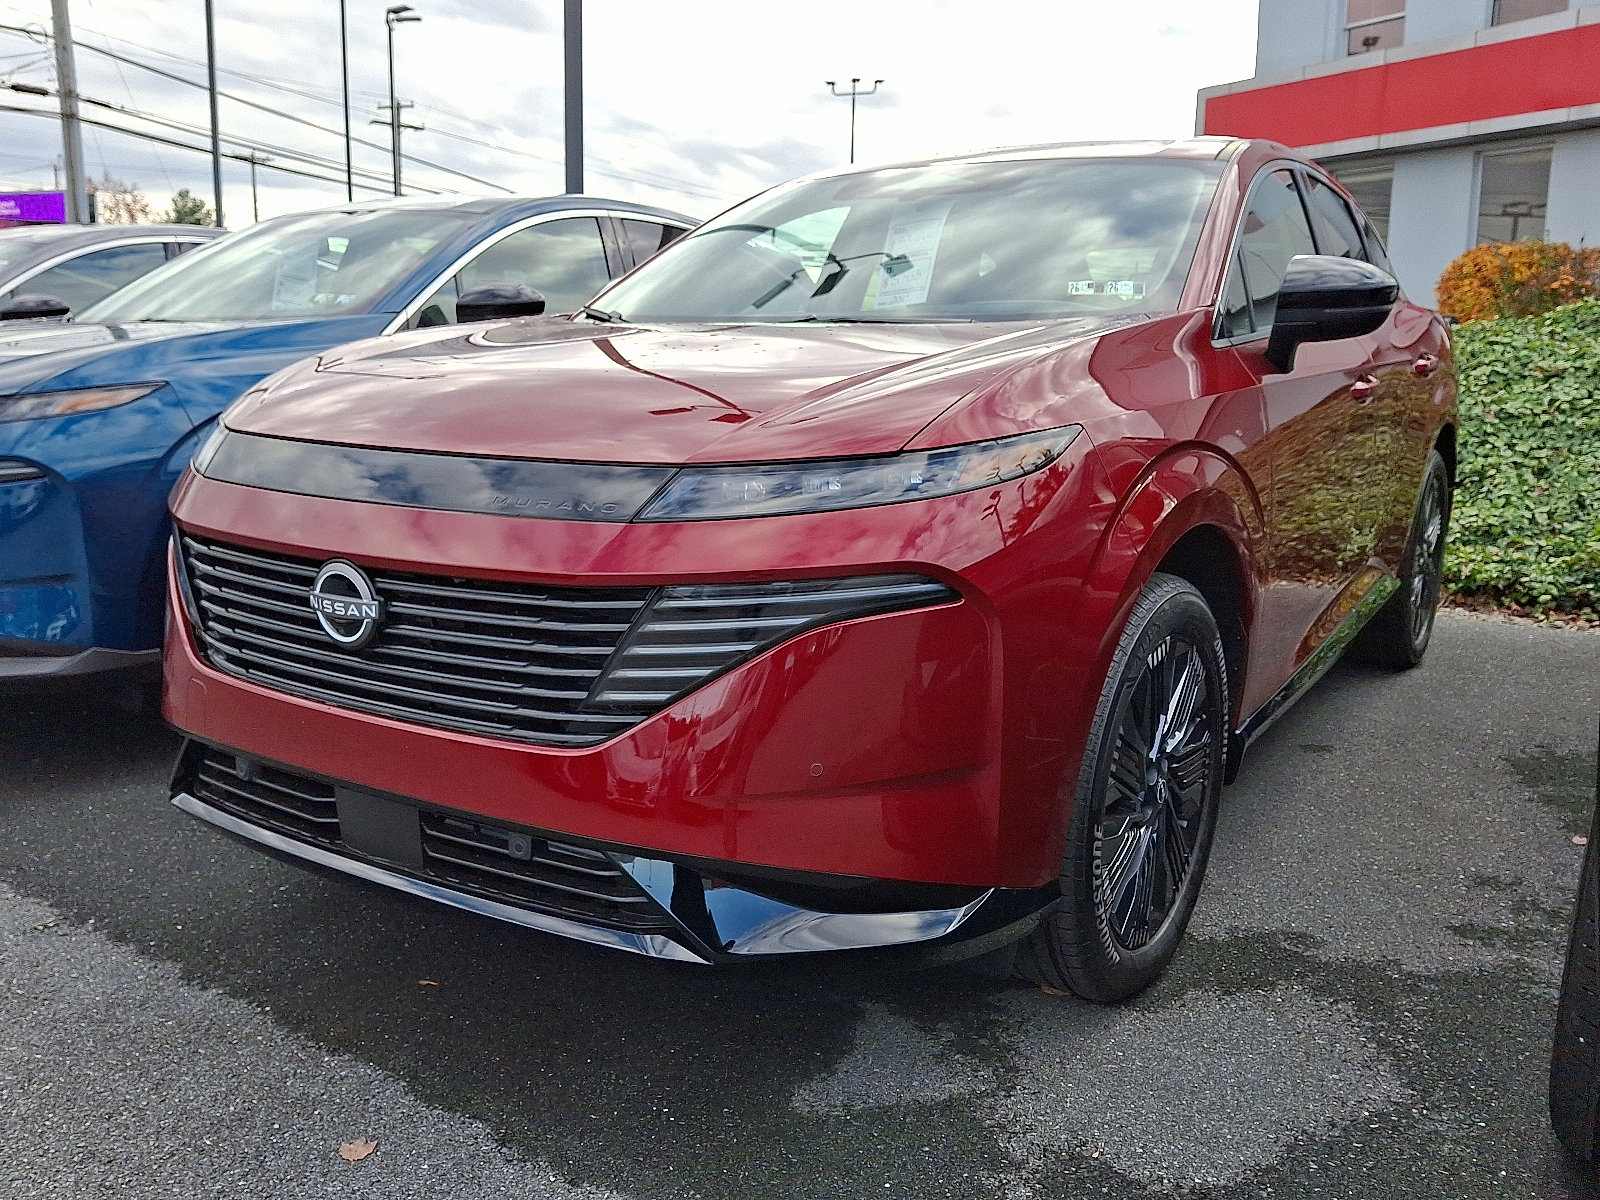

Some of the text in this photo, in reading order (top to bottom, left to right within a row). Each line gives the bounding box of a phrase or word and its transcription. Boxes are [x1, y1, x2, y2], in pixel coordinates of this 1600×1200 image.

[493, 495, 619, 514] MURANO
[309, 594, 377, 618] NISSAN
[1092, 824, 1121, 966] BRIDGESTONE
